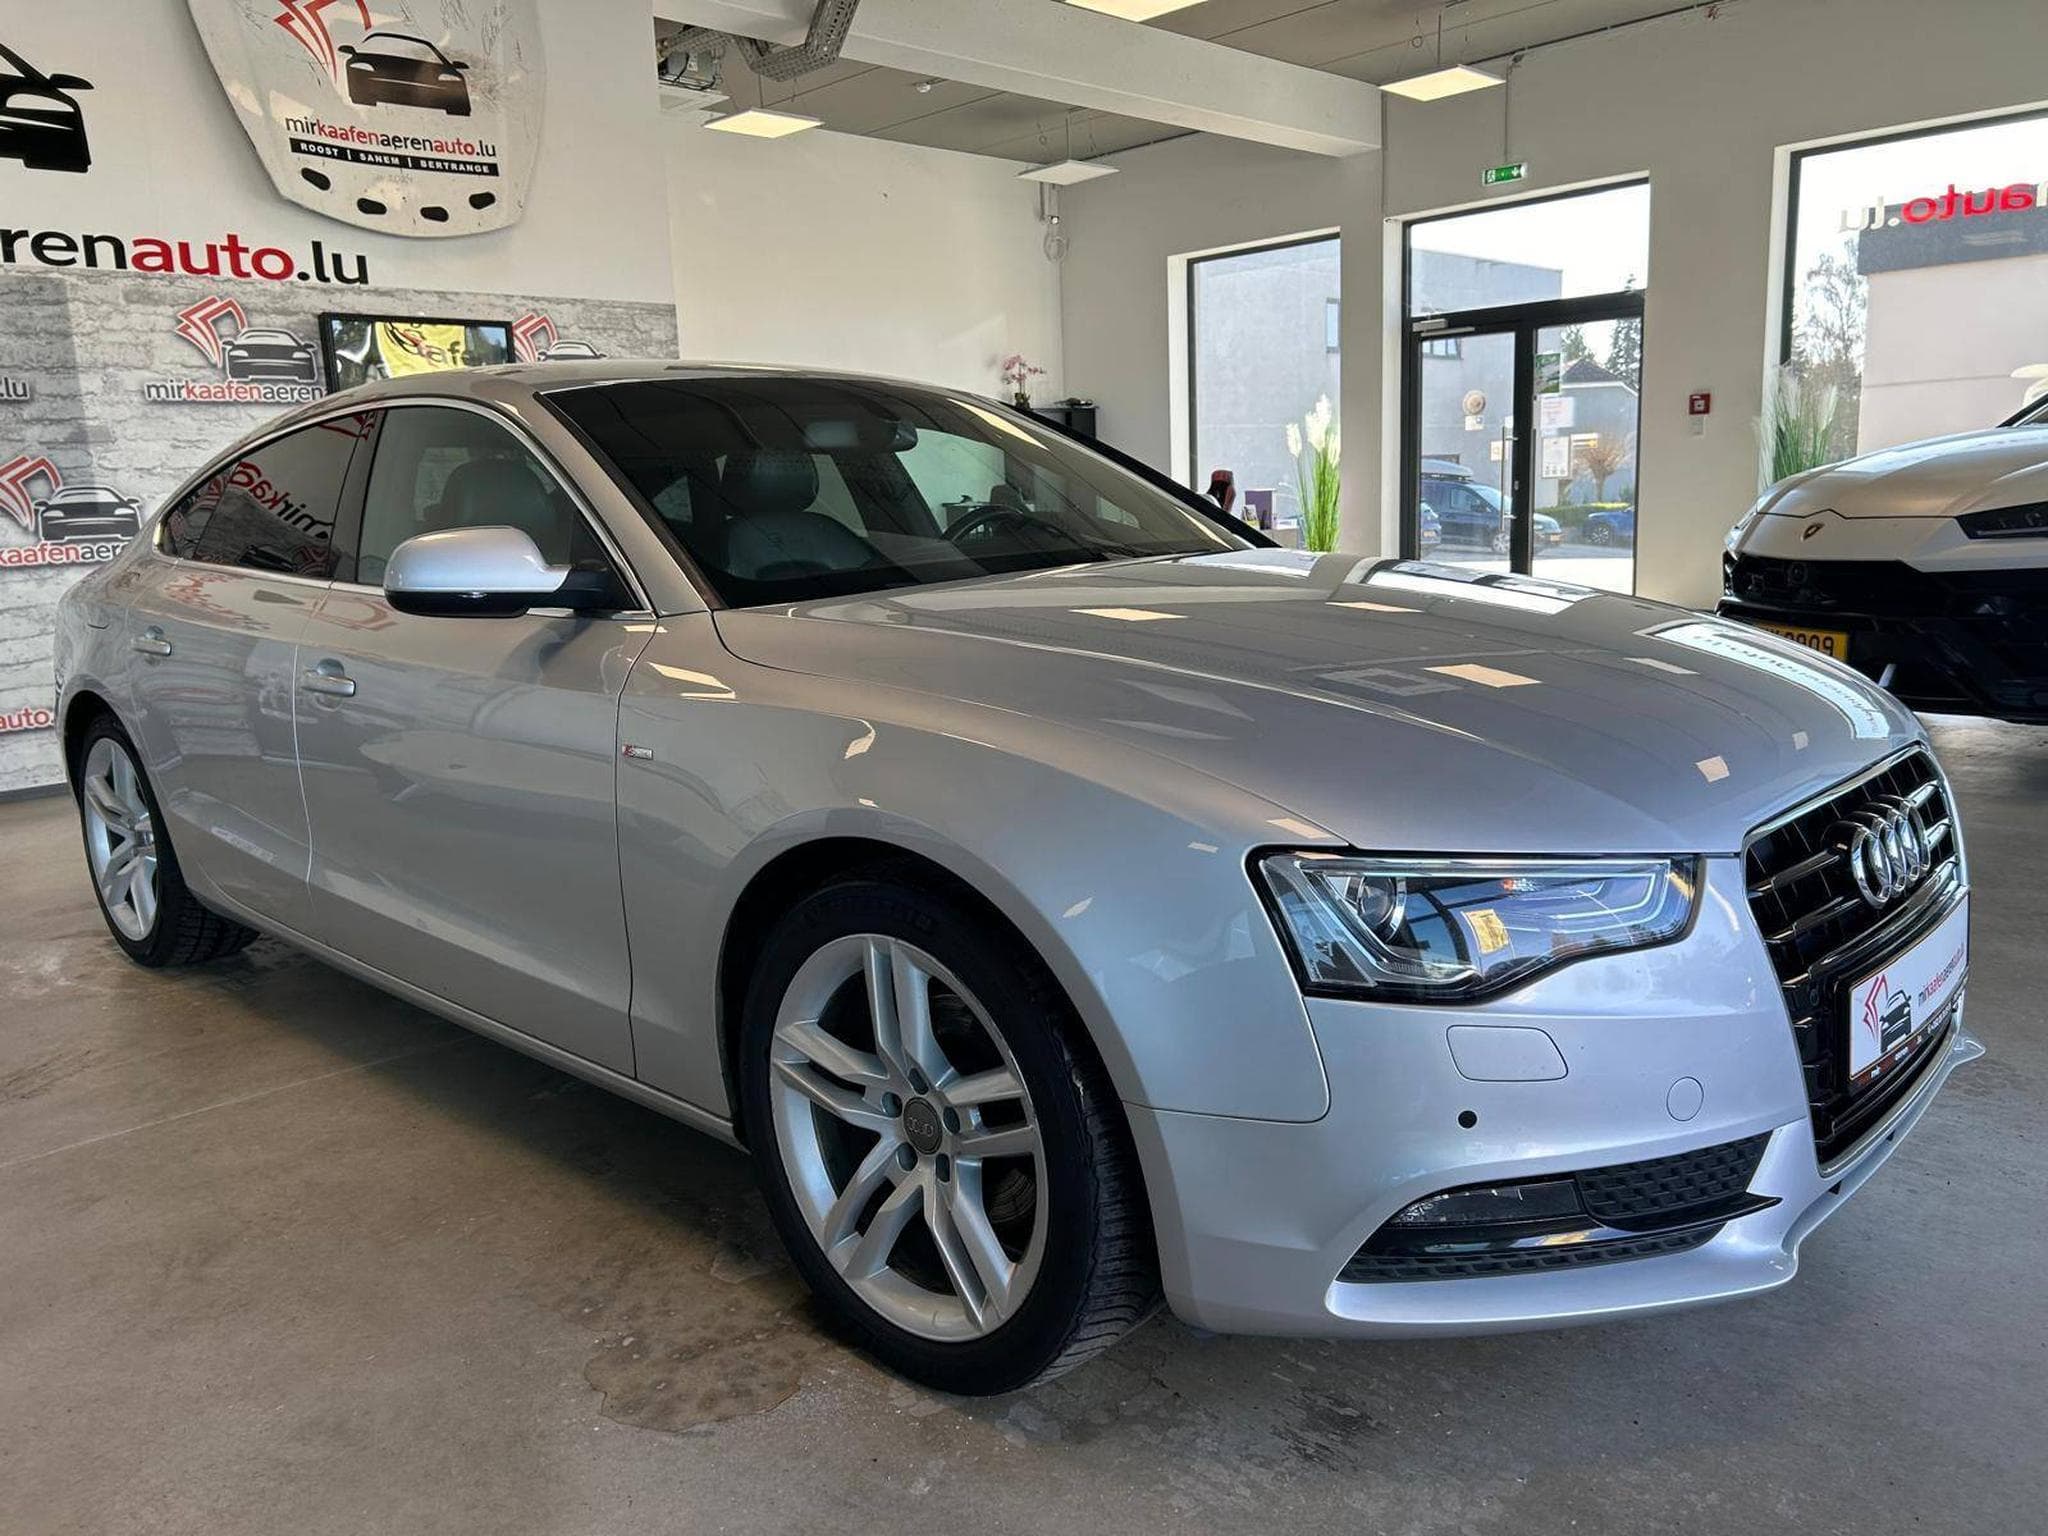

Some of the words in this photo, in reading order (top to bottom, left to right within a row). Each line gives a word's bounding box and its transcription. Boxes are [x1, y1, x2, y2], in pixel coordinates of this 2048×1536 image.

[285, 116, 497, 157] mirkaafenaerenauto.lu
[299, 142, 339, 157] ROOST
[359, 153, 400, 166] SANEM
[419, 160, 490, 174] BERTRANGE
